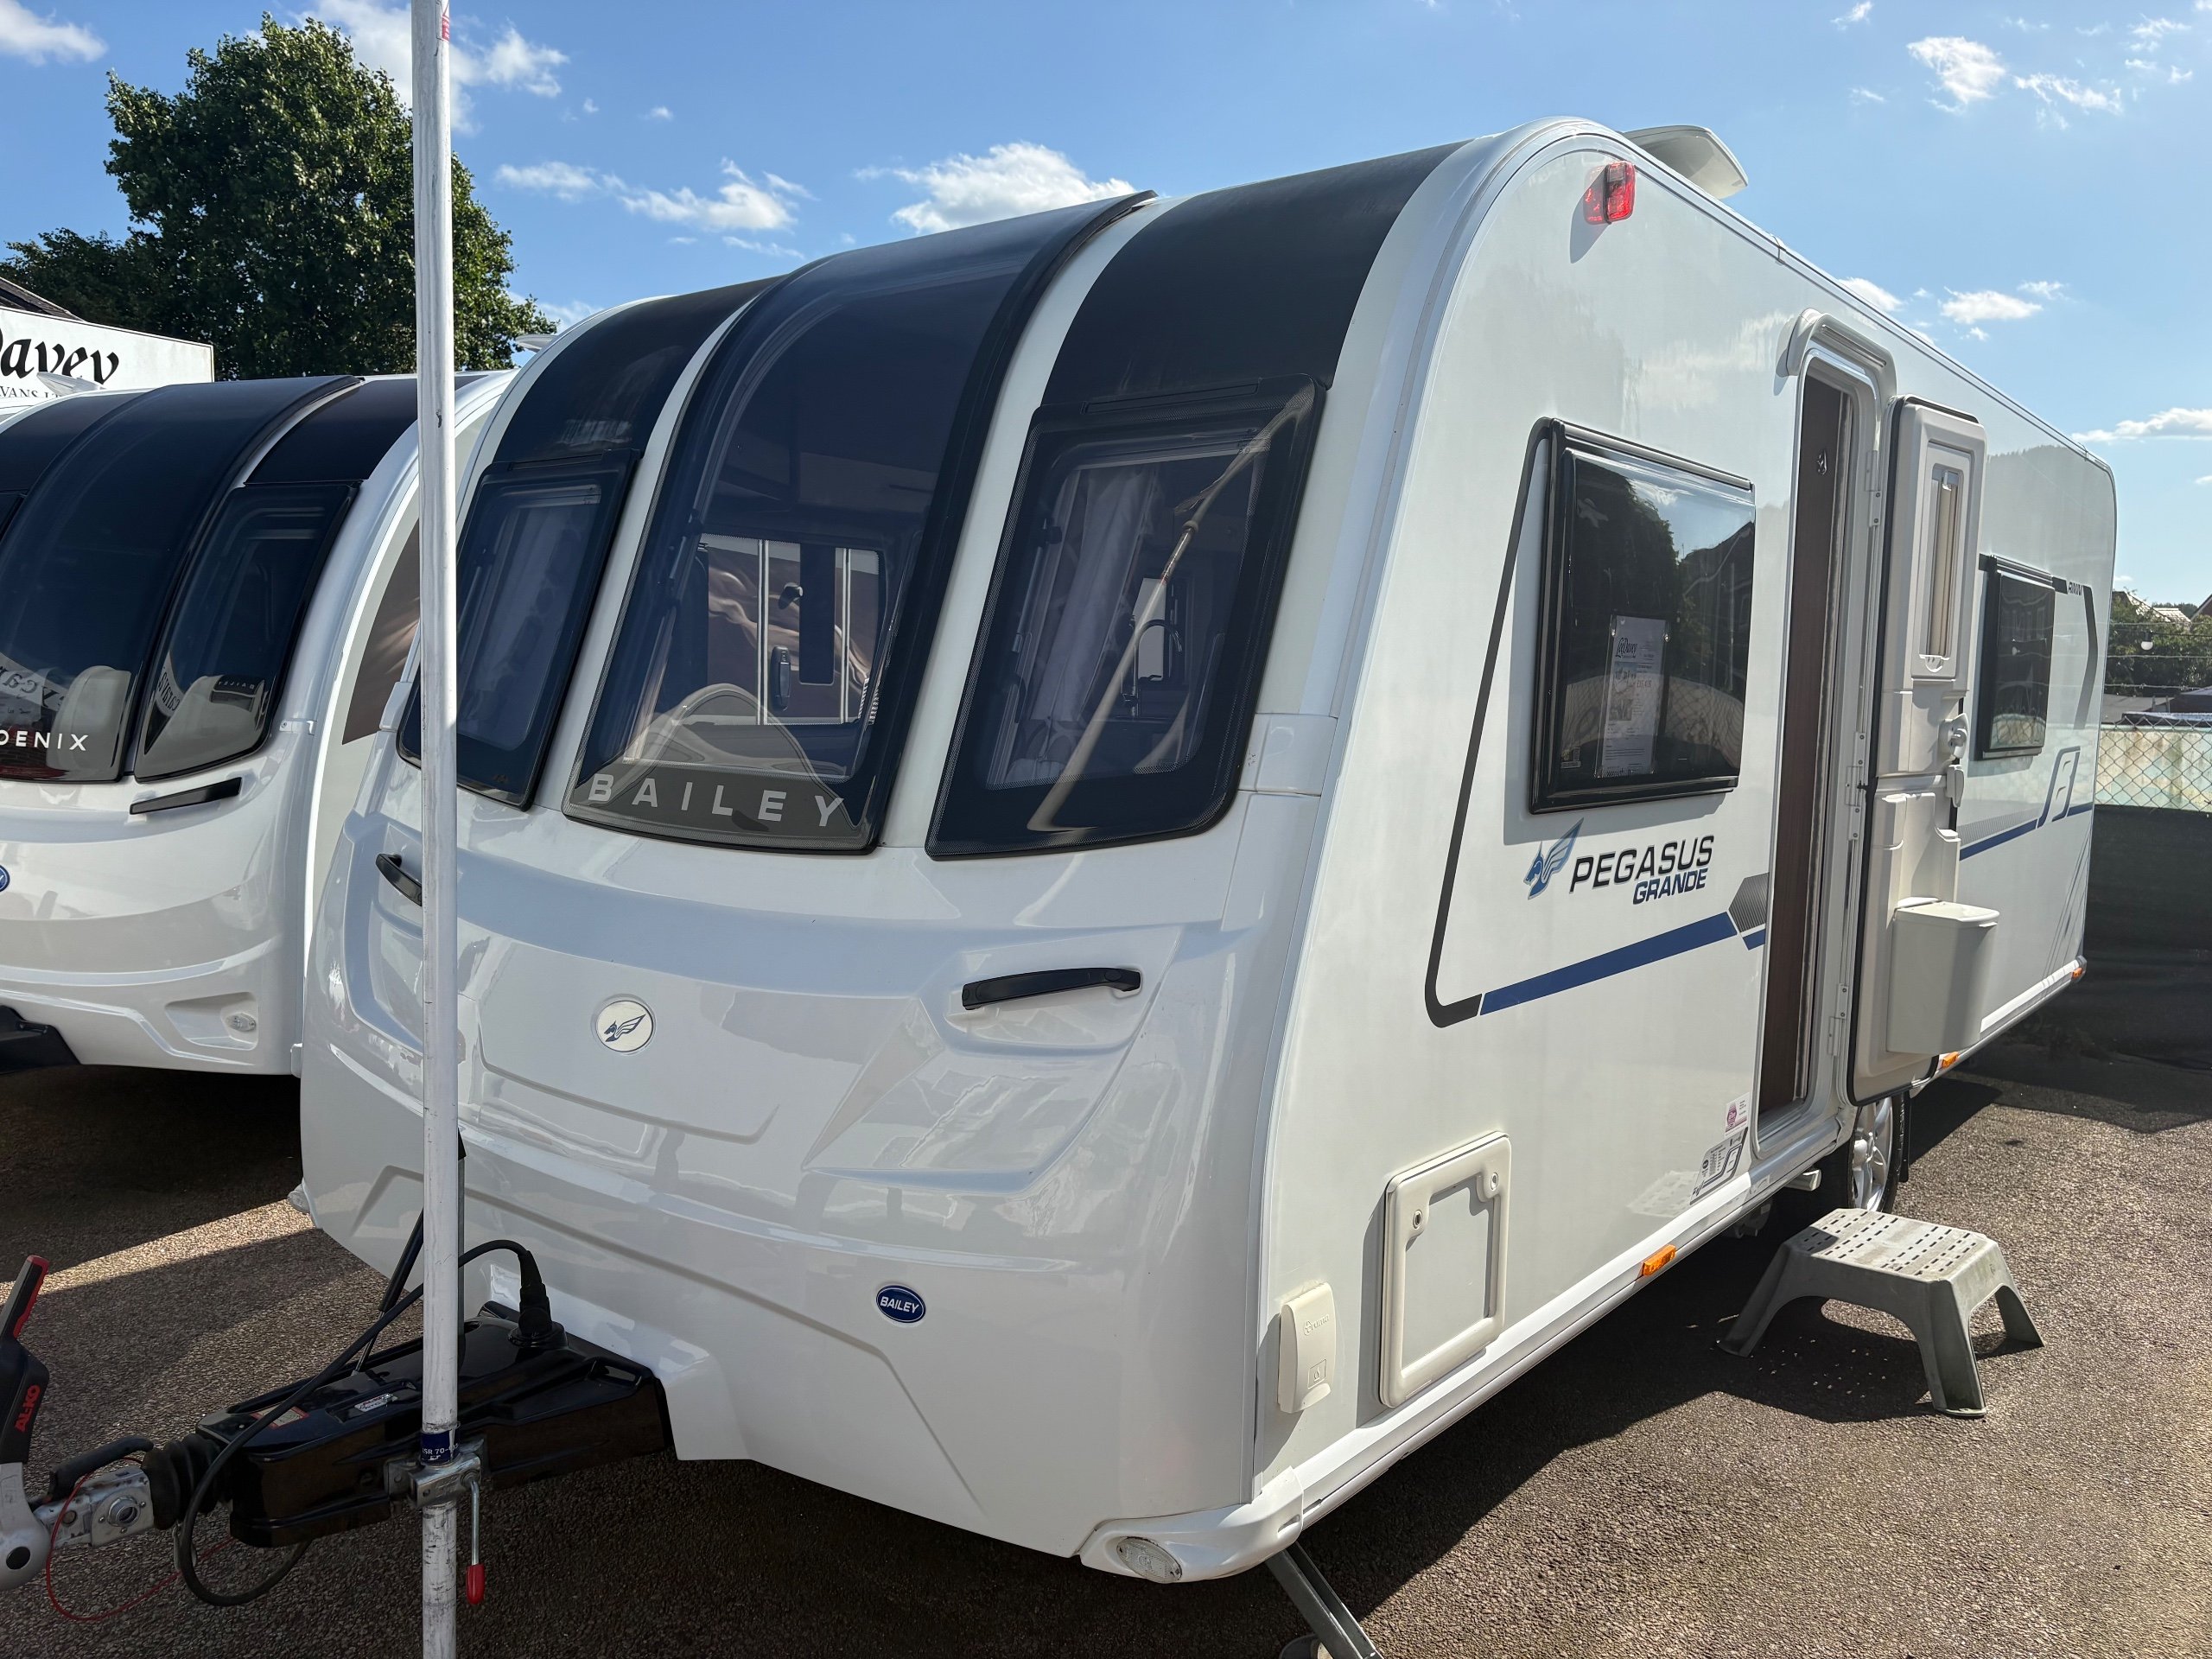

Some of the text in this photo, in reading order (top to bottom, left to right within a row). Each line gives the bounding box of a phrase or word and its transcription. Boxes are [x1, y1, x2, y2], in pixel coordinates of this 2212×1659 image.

[0, 329, 119, 389] avey
[588, 773, 844, 826] BAILEY
[1569, 835, 1715, 893] PEGASUS
[1632, 868, 1708, 905] GRANDE
[880, 1296, 919, 1313] BAILEY
